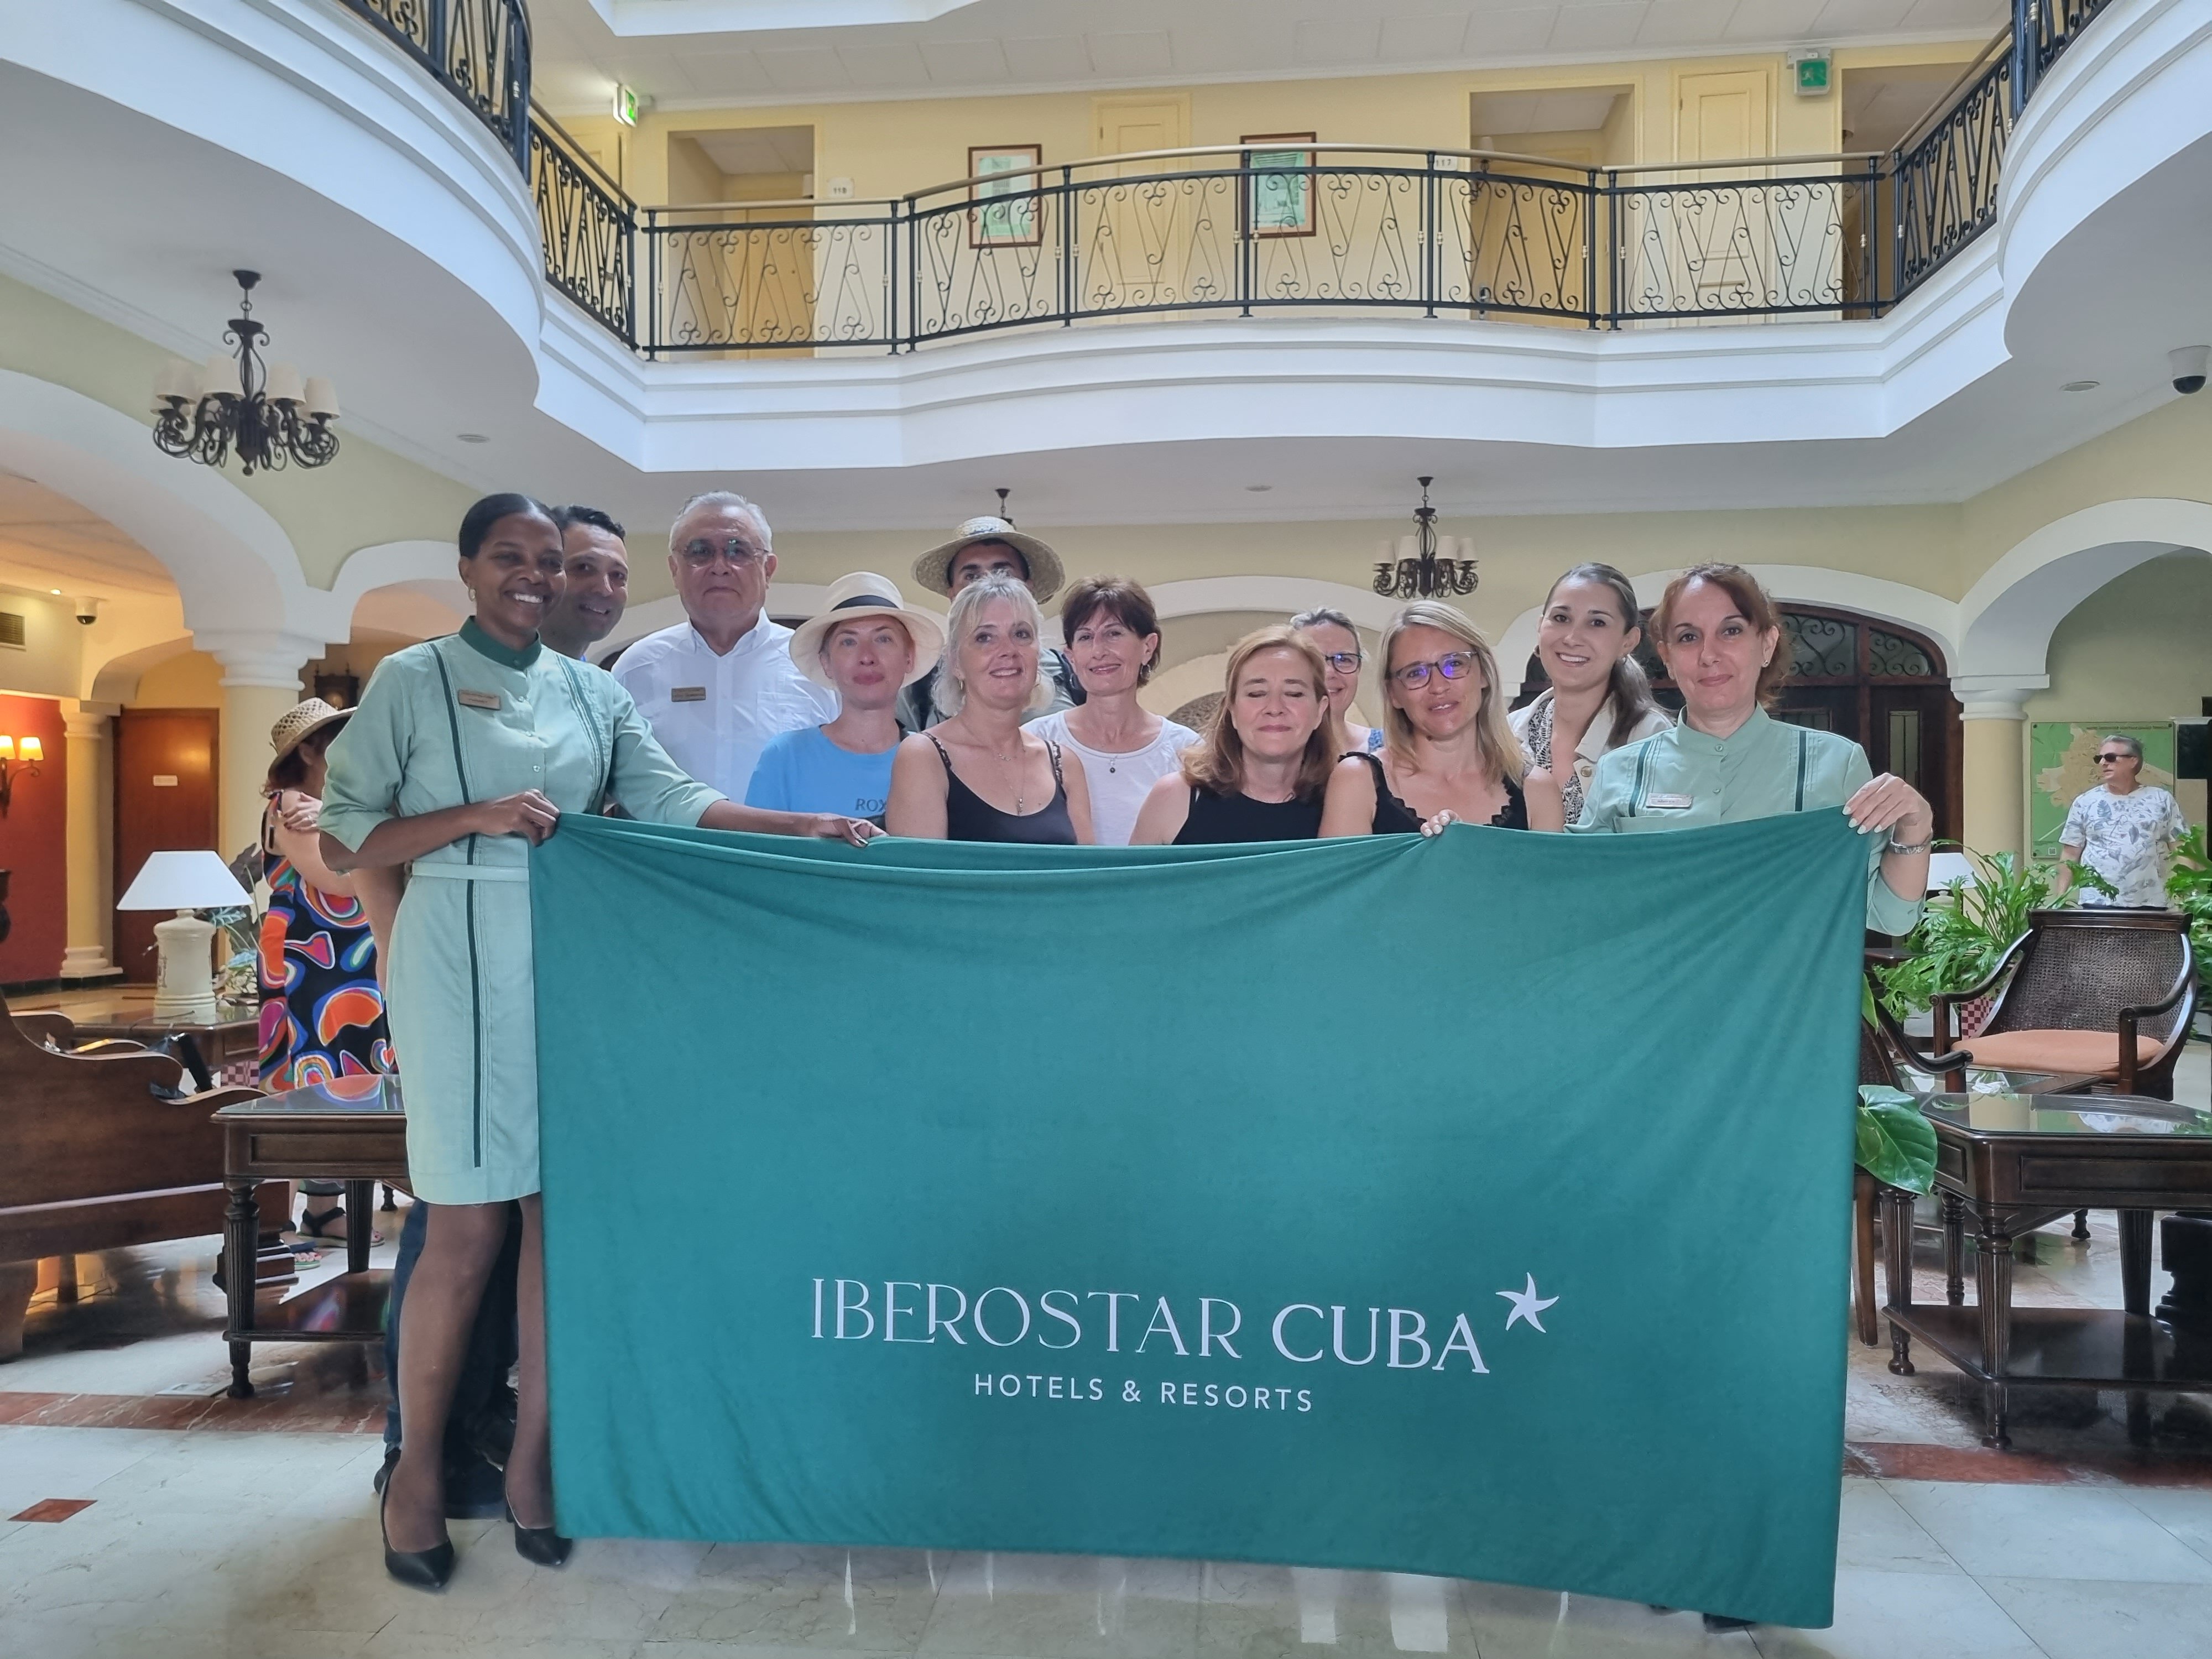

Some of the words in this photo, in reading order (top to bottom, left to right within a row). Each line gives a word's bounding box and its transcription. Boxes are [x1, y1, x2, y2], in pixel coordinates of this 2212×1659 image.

[811, 1278, 1242, 1359] IBEROSTAR
[1272, 1303, 1490, 1374] CUBA
[975, 1373, 1103, 1401] HOTELS
[1122, 1380, 1141, 1402] &
[1161, 1382, 1311, 1412] RESORTS
